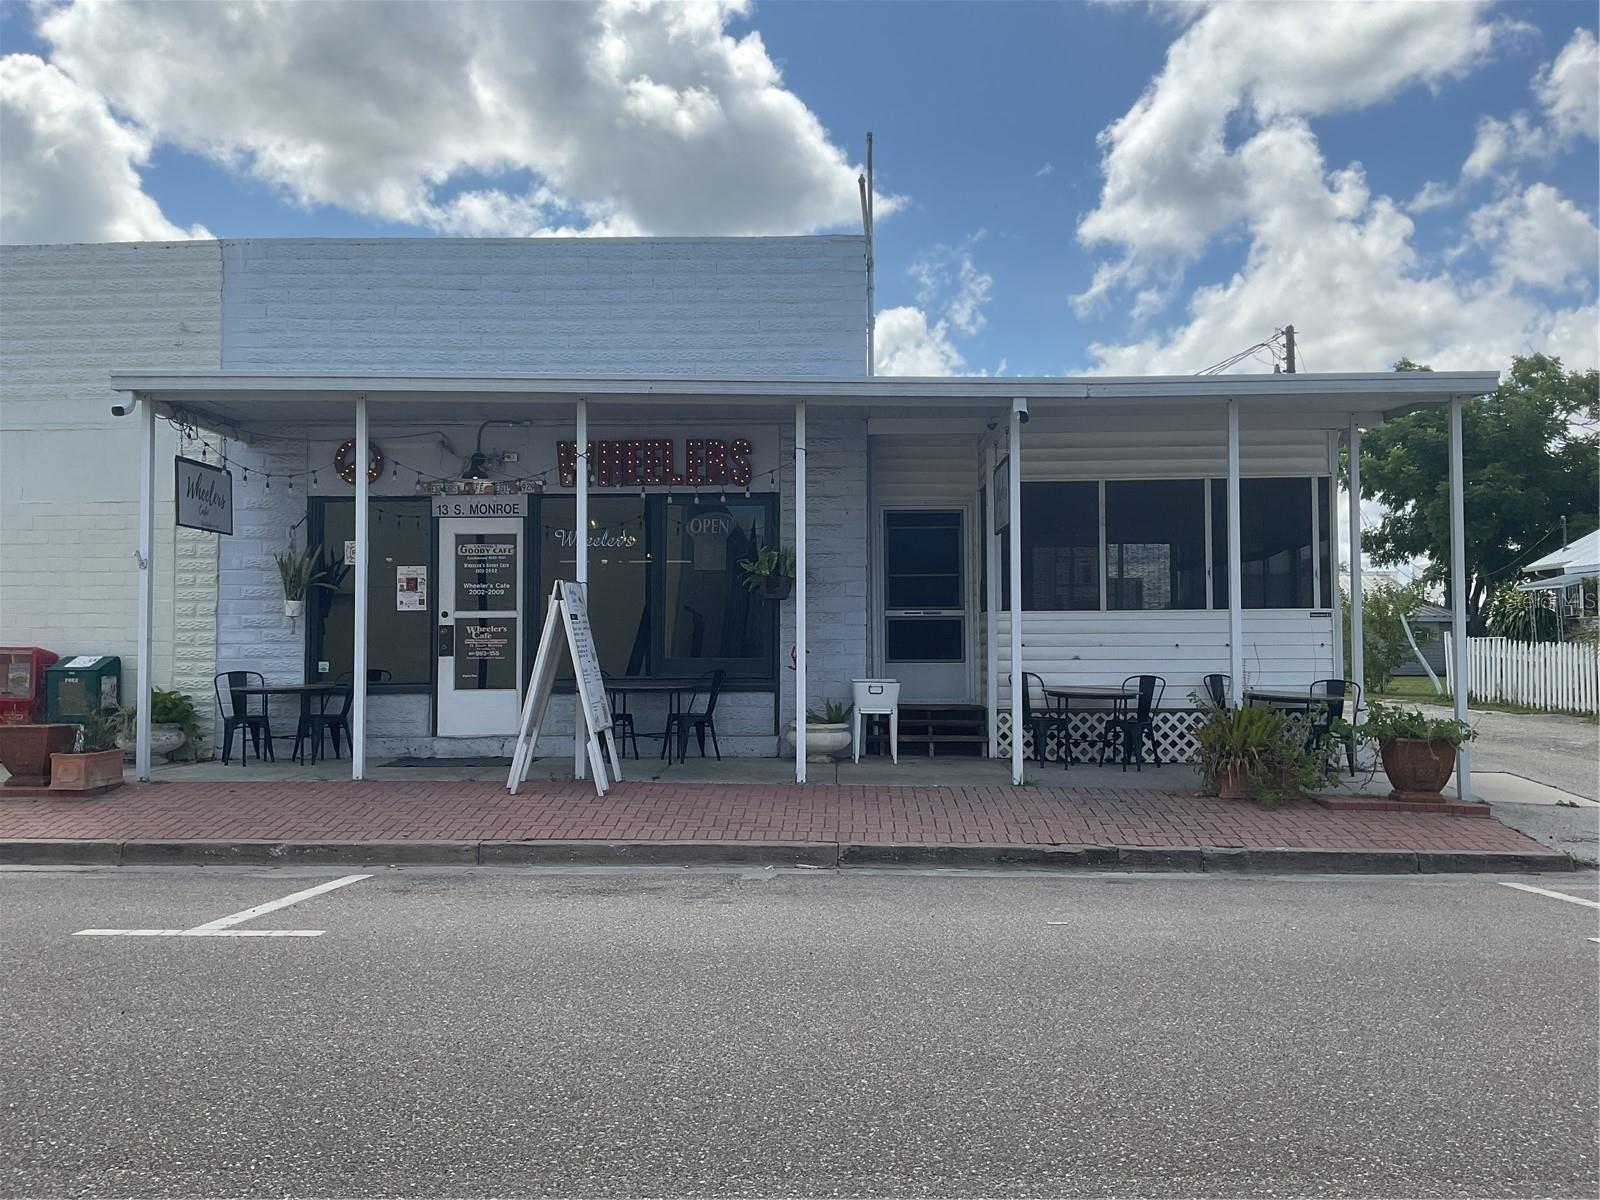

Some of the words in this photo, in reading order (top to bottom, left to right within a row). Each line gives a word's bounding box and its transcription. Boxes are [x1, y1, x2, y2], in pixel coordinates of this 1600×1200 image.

[556, 439, 752, 487] WHEELERS
[186, 472, 227, 510] Wheelers
[436, 504, 449, 516] 13
[453, 503, 465, 516] S.
[469, 503, 520, 515] MONROE
[690, 518, 730, 535] OPEN
[554, 529, 636, 548] Weeler's
[465, 625, 508, 634] Wheeler's
